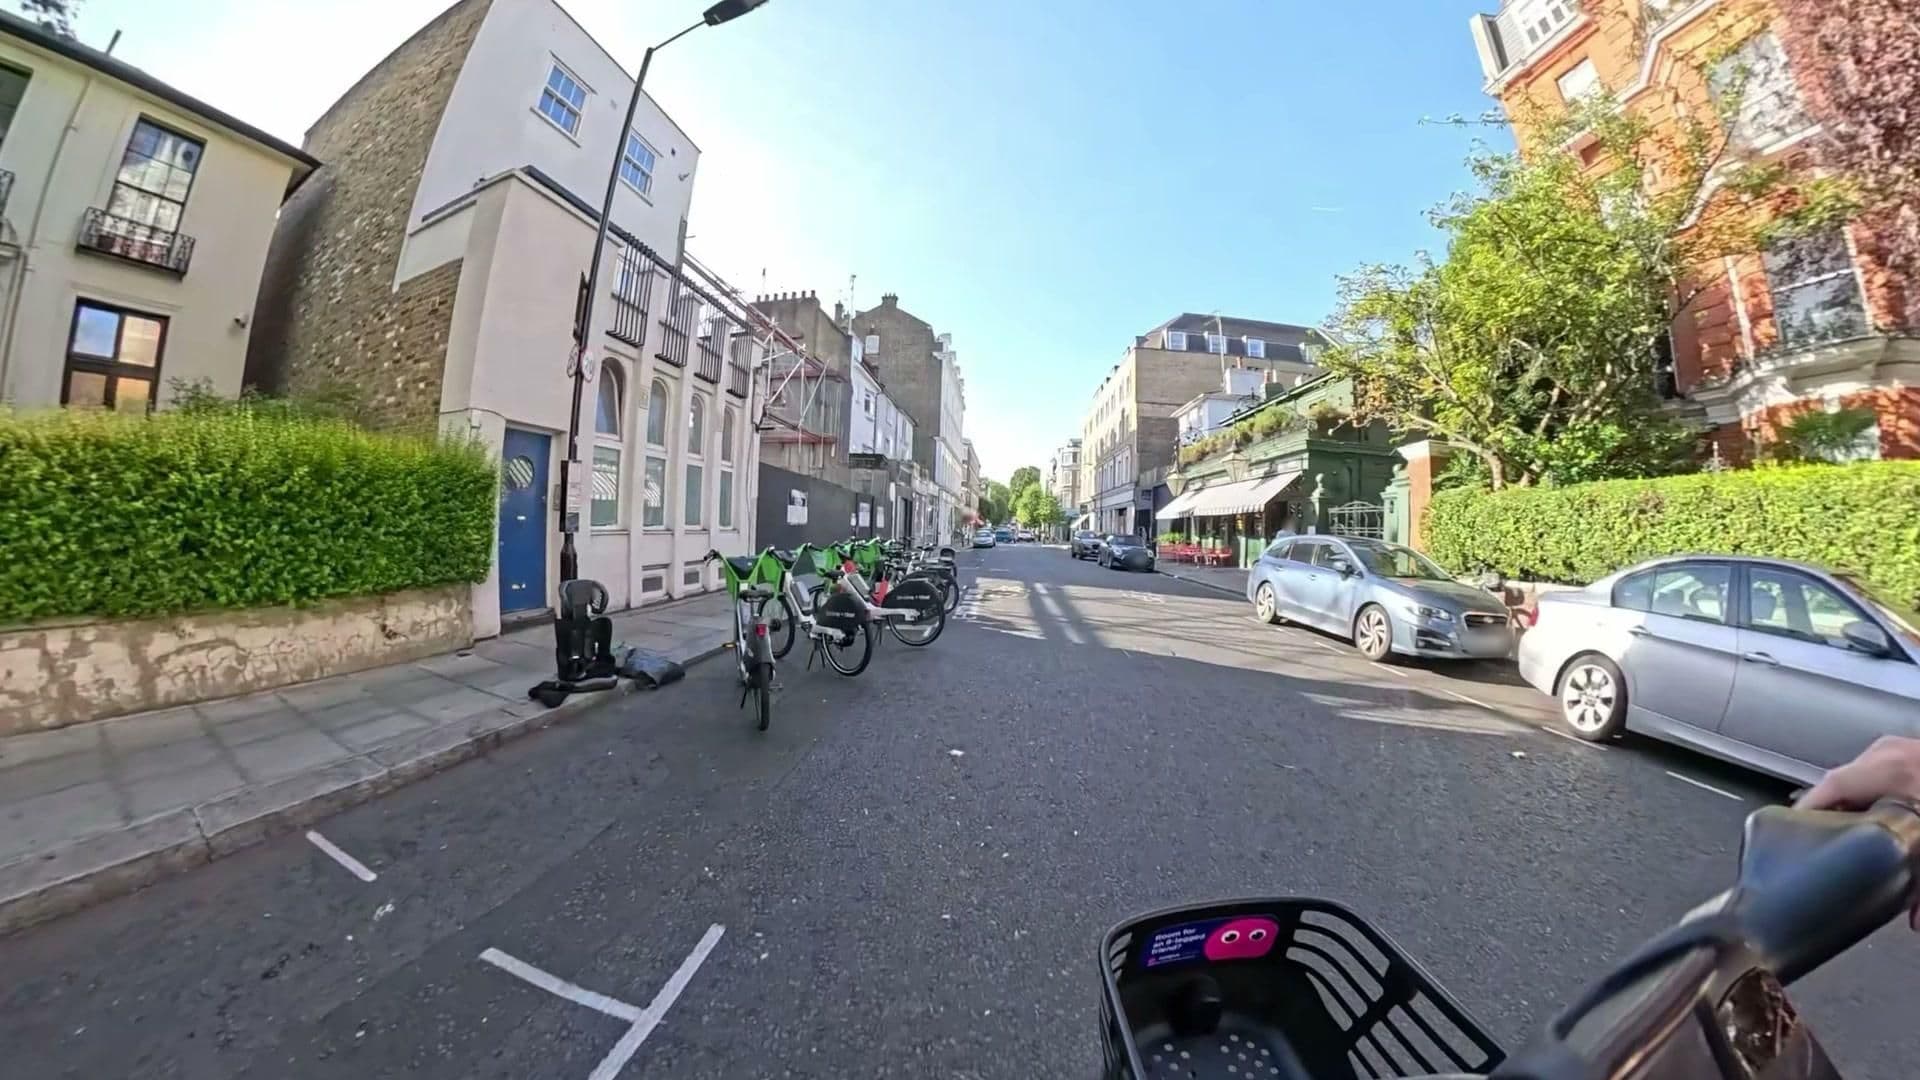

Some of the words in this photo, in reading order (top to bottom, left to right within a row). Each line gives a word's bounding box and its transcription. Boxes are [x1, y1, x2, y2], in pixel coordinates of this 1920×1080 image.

[1155, 931, 1181, 941] Room
[1152, 943, 1182, 955] friend?
[1153, 941, 1164, 949] an
